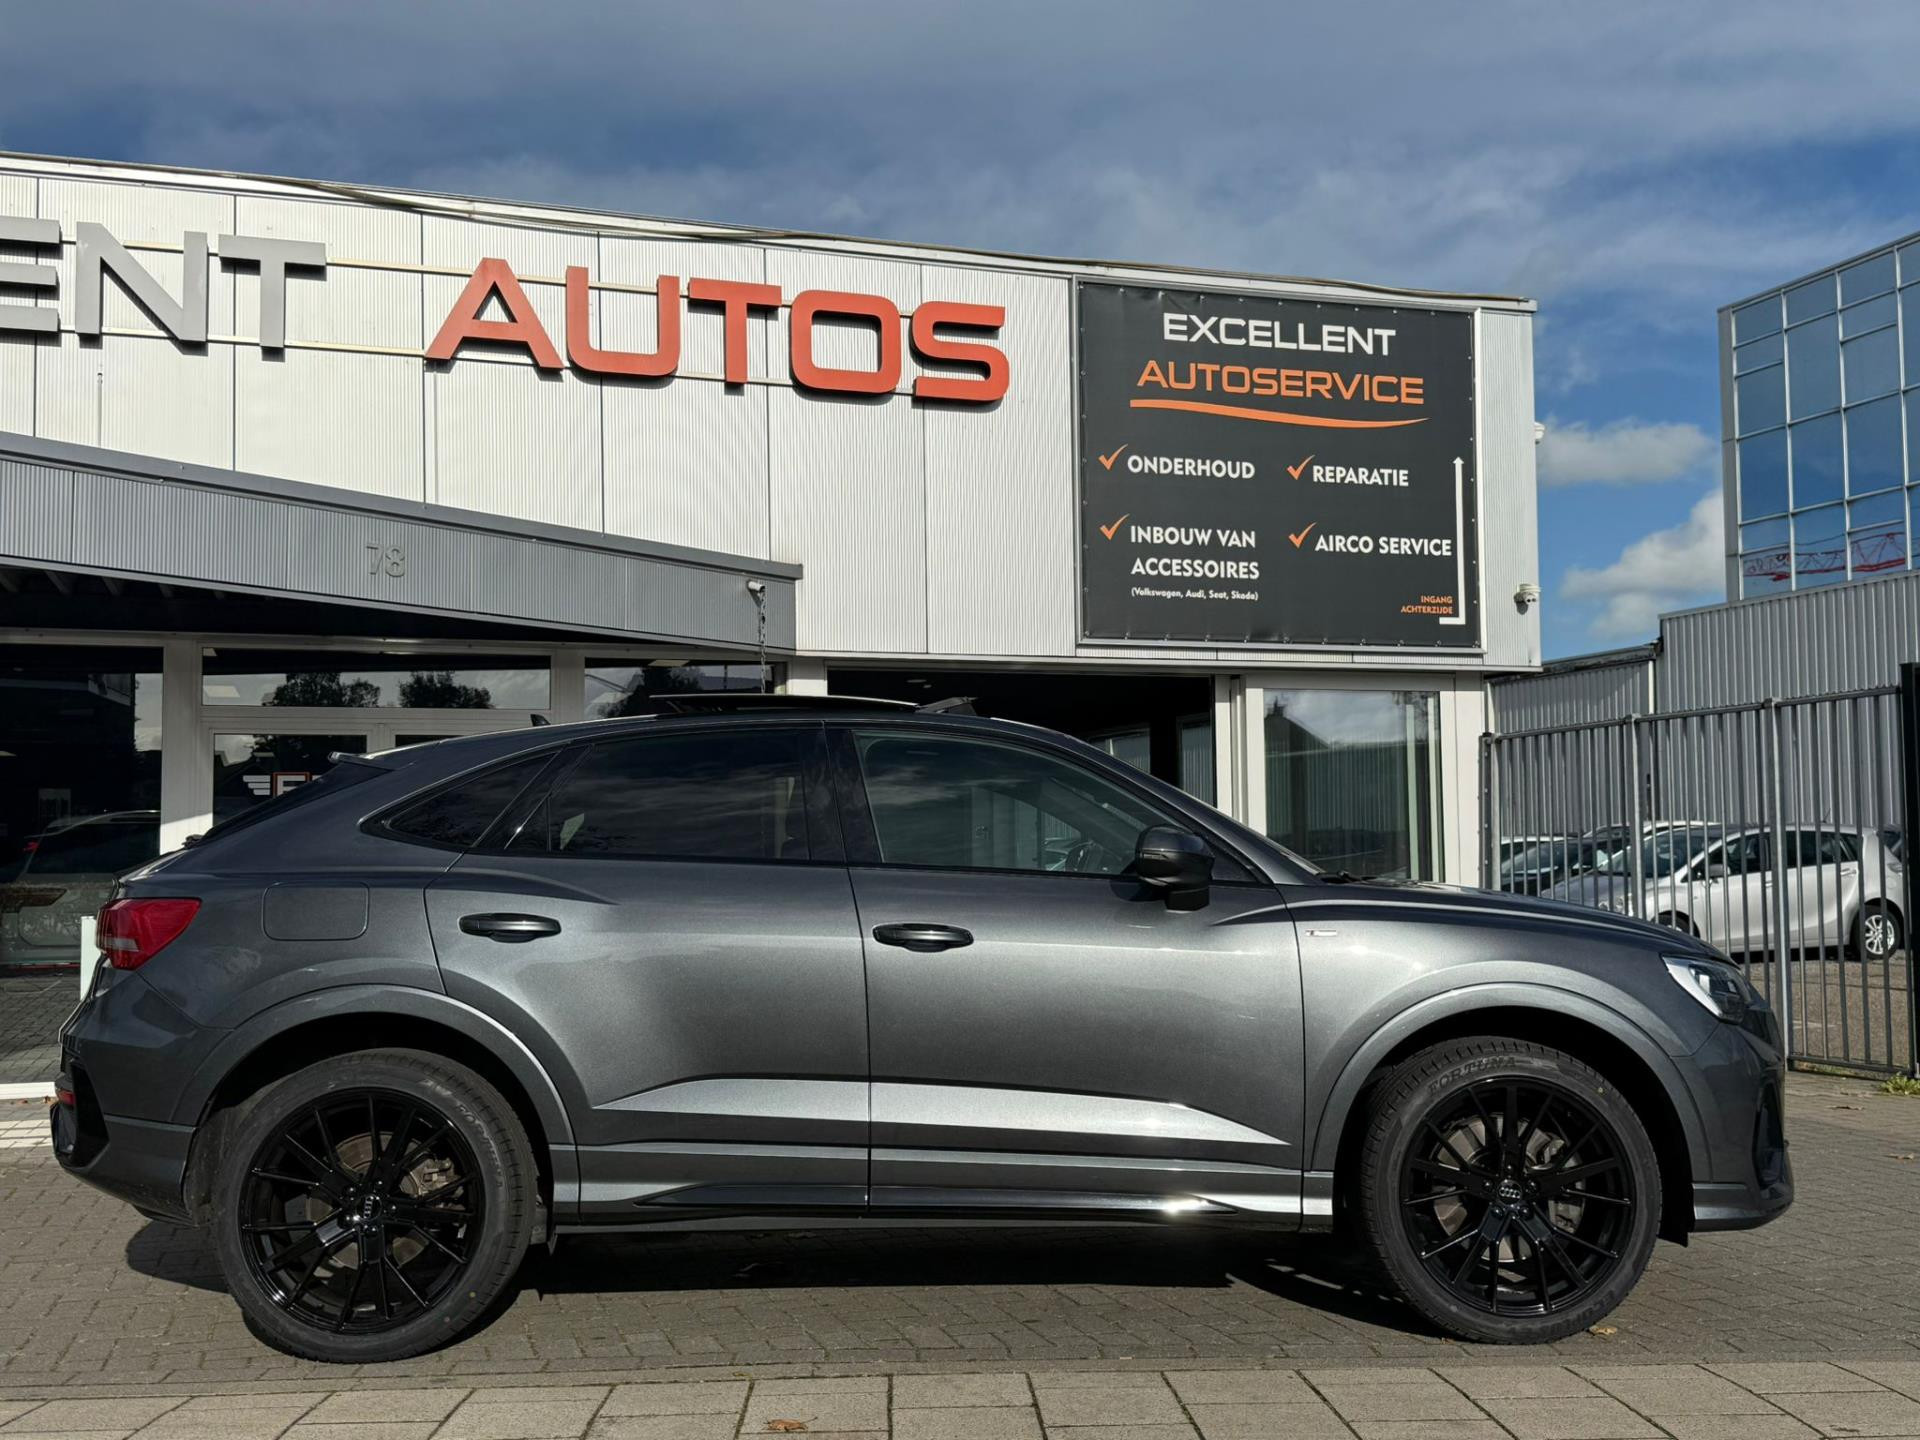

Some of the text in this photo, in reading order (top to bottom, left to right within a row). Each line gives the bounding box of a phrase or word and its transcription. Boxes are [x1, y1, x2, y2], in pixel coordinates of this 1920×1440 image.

[424, 257, 1010, 402] AUTOS
[1163, 312, 1396, 356] EXCELLENT
[1137, 359, 1425, 405] AUTOSERVICE
[1127, 455, 1256, 480] ONDERHOUD
[1312, 464, 1410, 487] REPARATIE
[1130, 525, 1256, 549] INBOUW VAN
[1315, 534, 1453, 557] AIRCO SERVICE
[366, 544, 406, 578] 78
[1130, 557, 1260, 580] ACCESSOIRES
[1400, 605, 1453, 614] ACHTERZIJDE
[1420, 595, 1453, 604] INGANG
